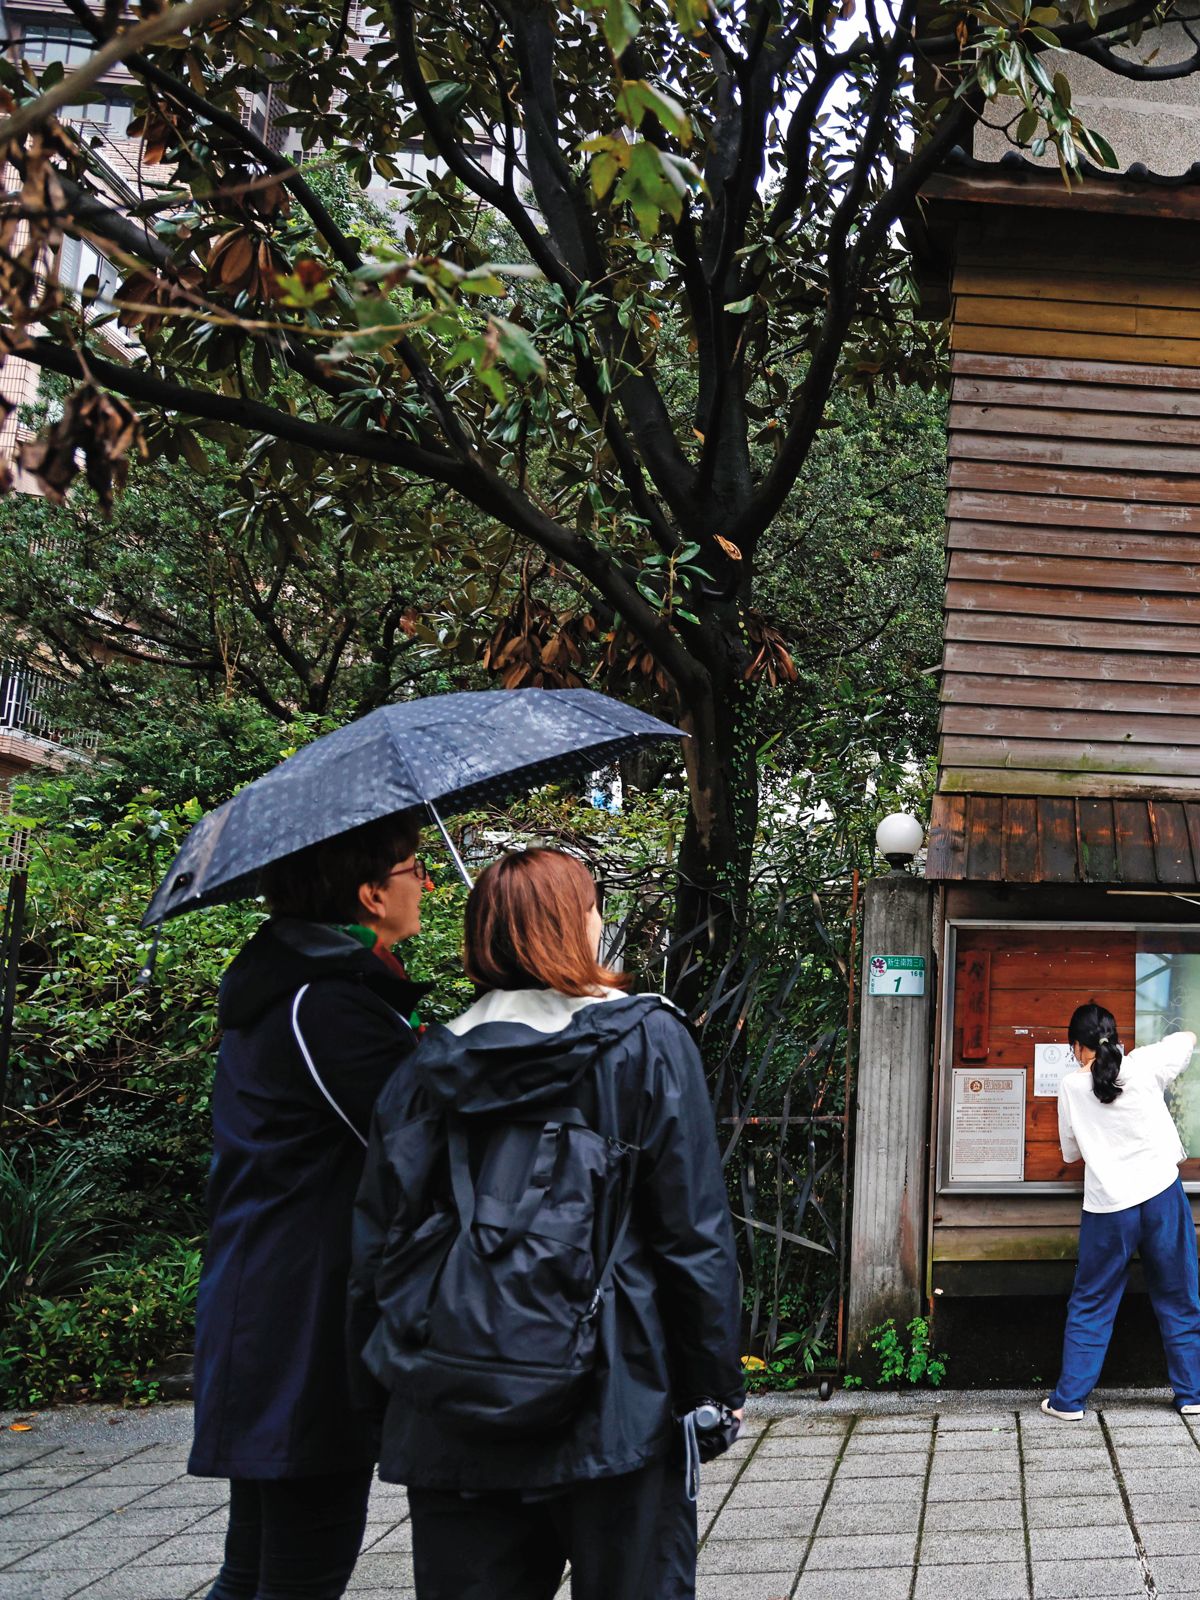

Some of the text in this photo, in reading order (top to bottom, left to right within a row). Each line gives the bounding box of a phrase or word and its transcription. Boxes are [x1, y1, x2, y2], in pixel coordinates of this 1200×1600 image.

[887, 958, 924, 967] 新生南路三段
[894, 976, 902, 993] 1
